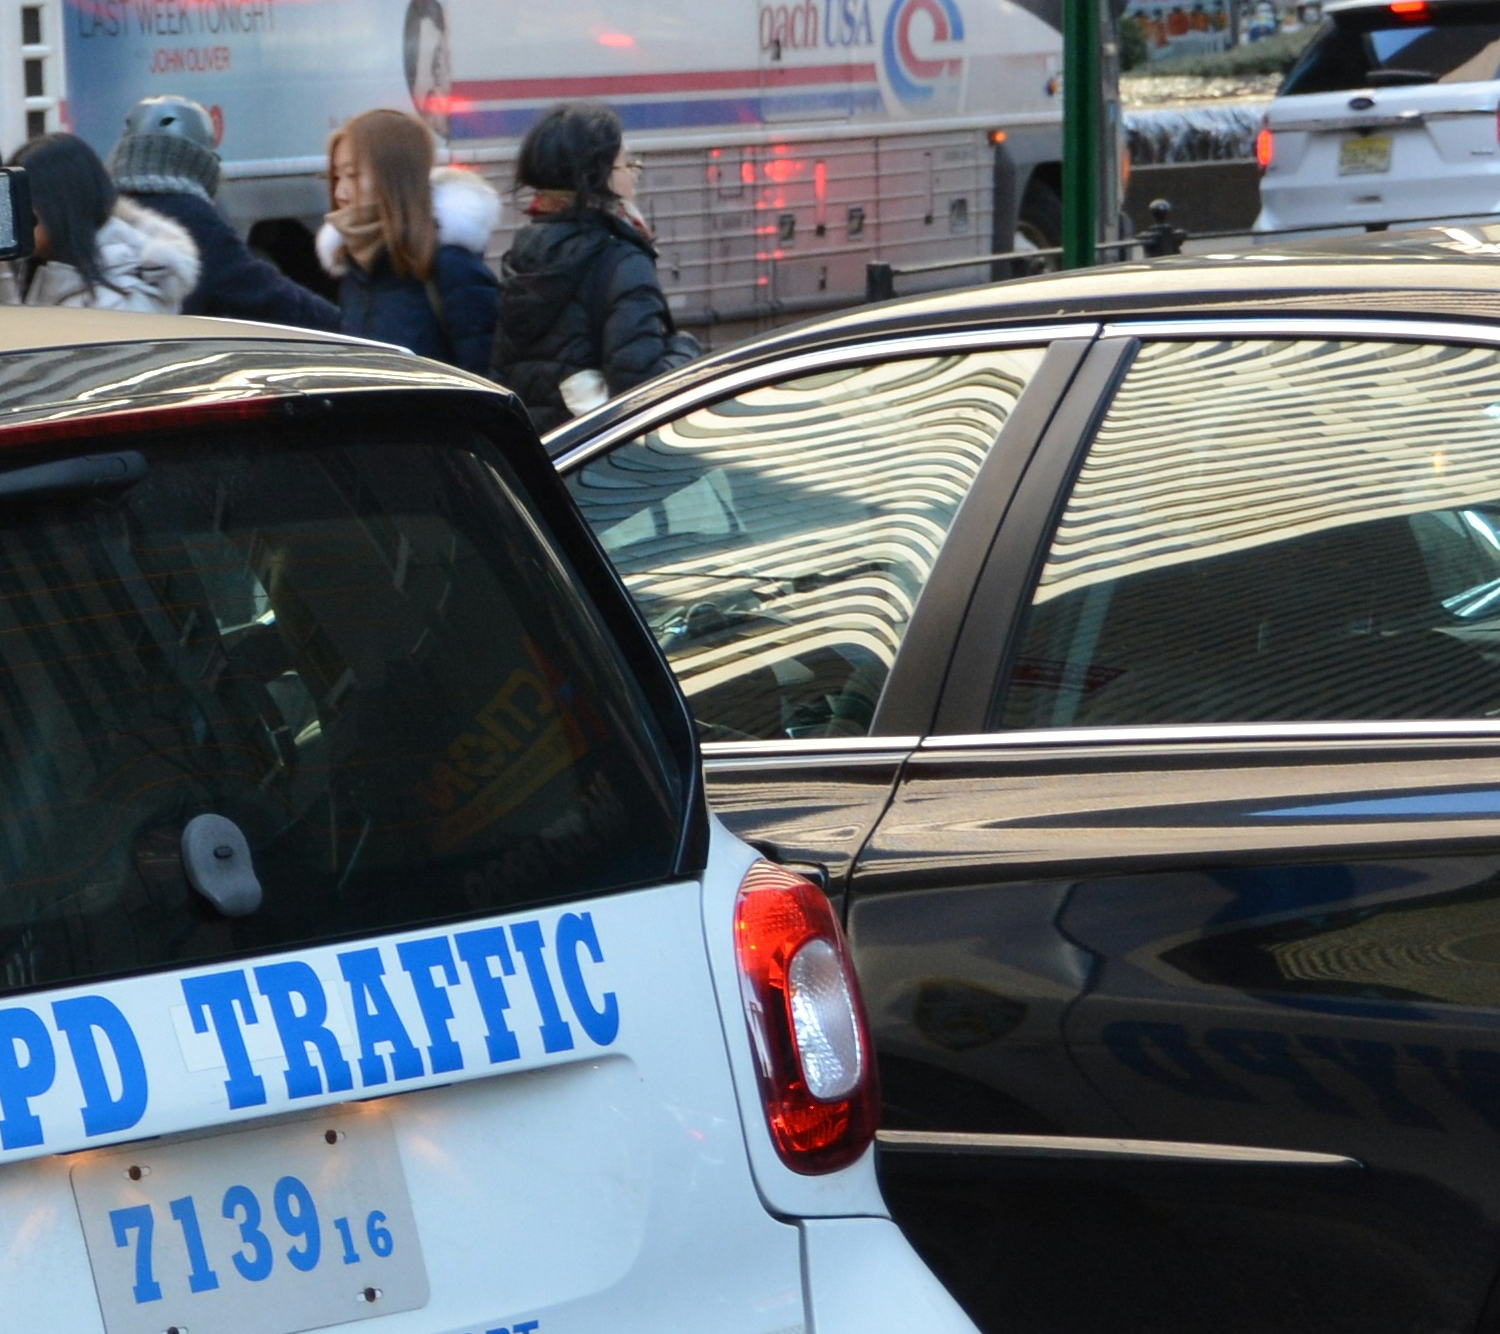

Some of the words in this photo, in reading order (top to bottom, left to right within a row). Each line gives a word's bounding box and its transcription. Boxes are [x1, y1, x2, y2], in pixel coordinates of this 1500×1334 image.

[152, 48, 187, 74] JOHN
[187, 46, 230, 72] OLIVER
[179, 911, 619, 1111] TRAFFIC
[108, 1175, 320, 1305] 7139
[333, 1209, 393, 1266] 16
